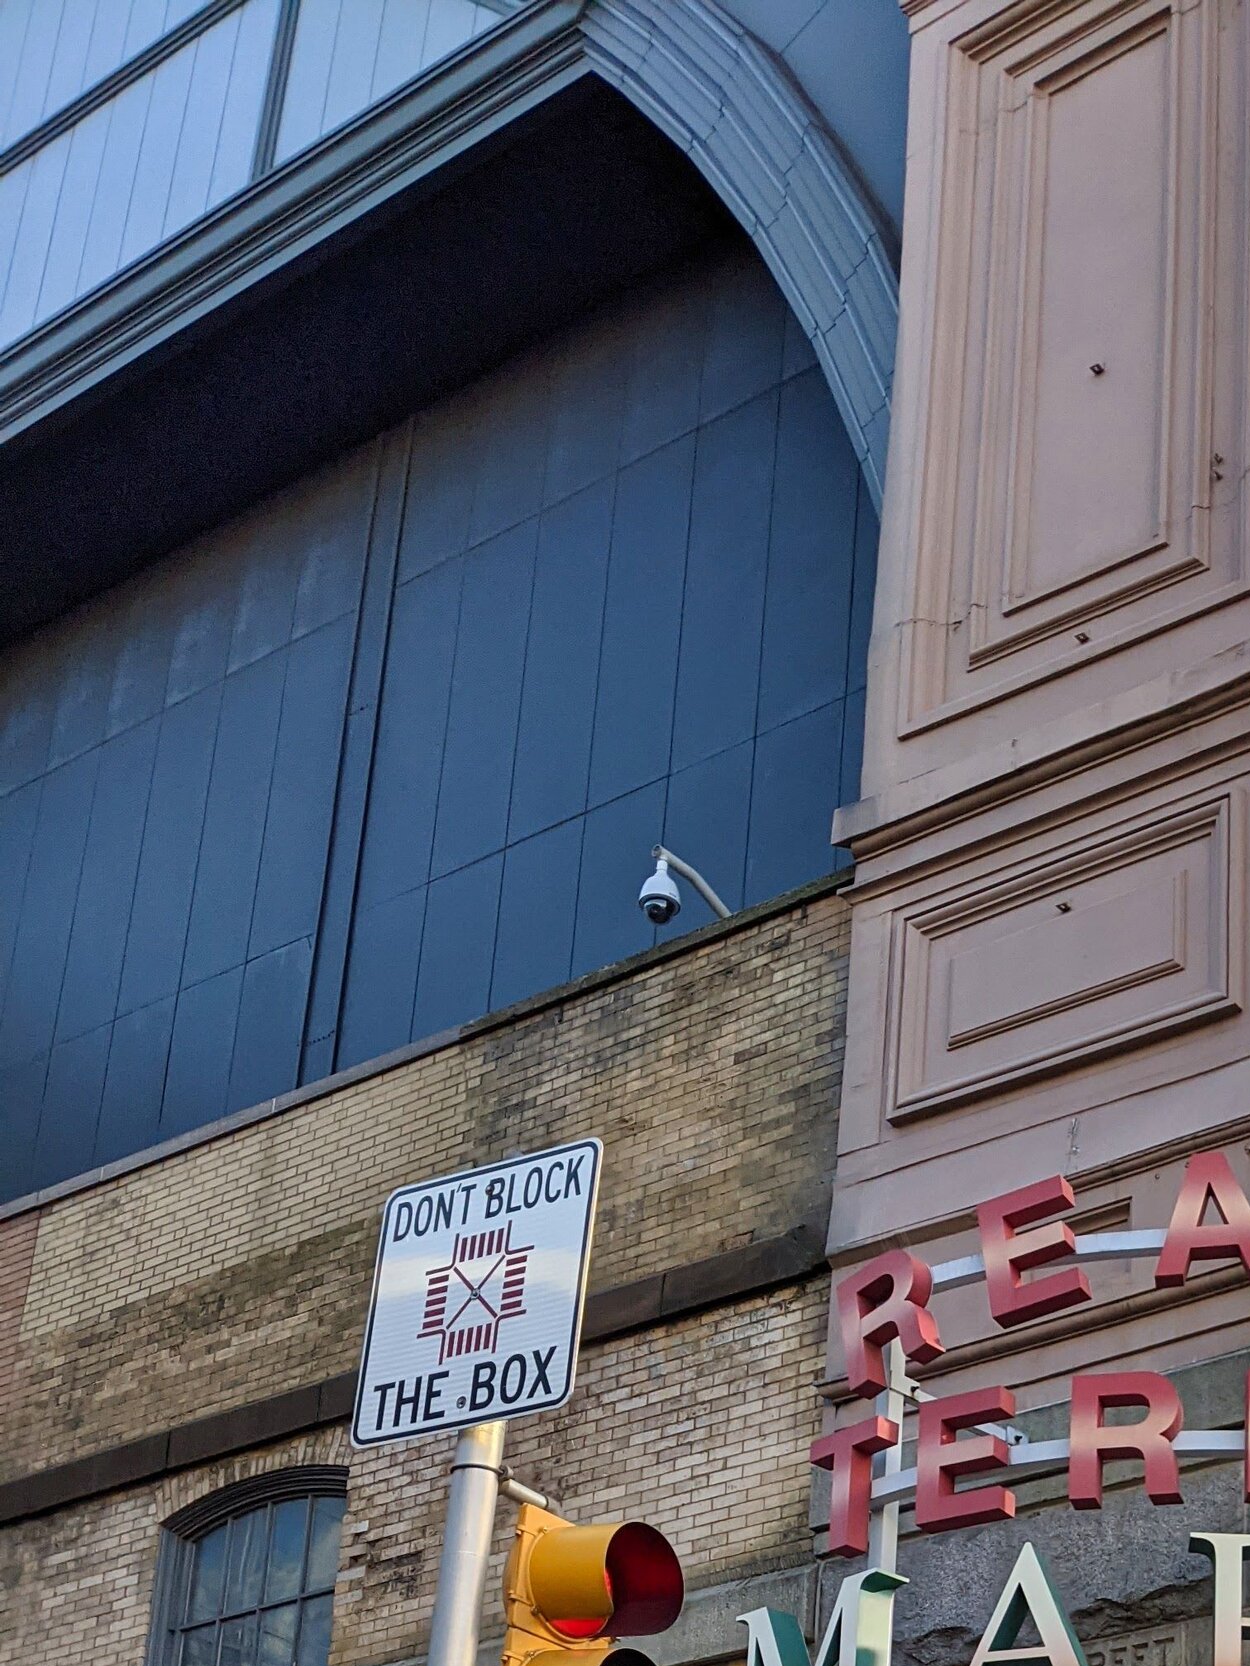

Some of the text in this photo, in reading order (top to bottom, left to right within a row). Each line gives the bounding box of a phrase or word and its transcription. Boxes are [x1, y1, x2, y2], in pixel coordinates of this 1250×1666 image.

[393, 1155, 586, 1243] DON'T BLOCK
[374, 1345, 558, 1431] THE BOX
